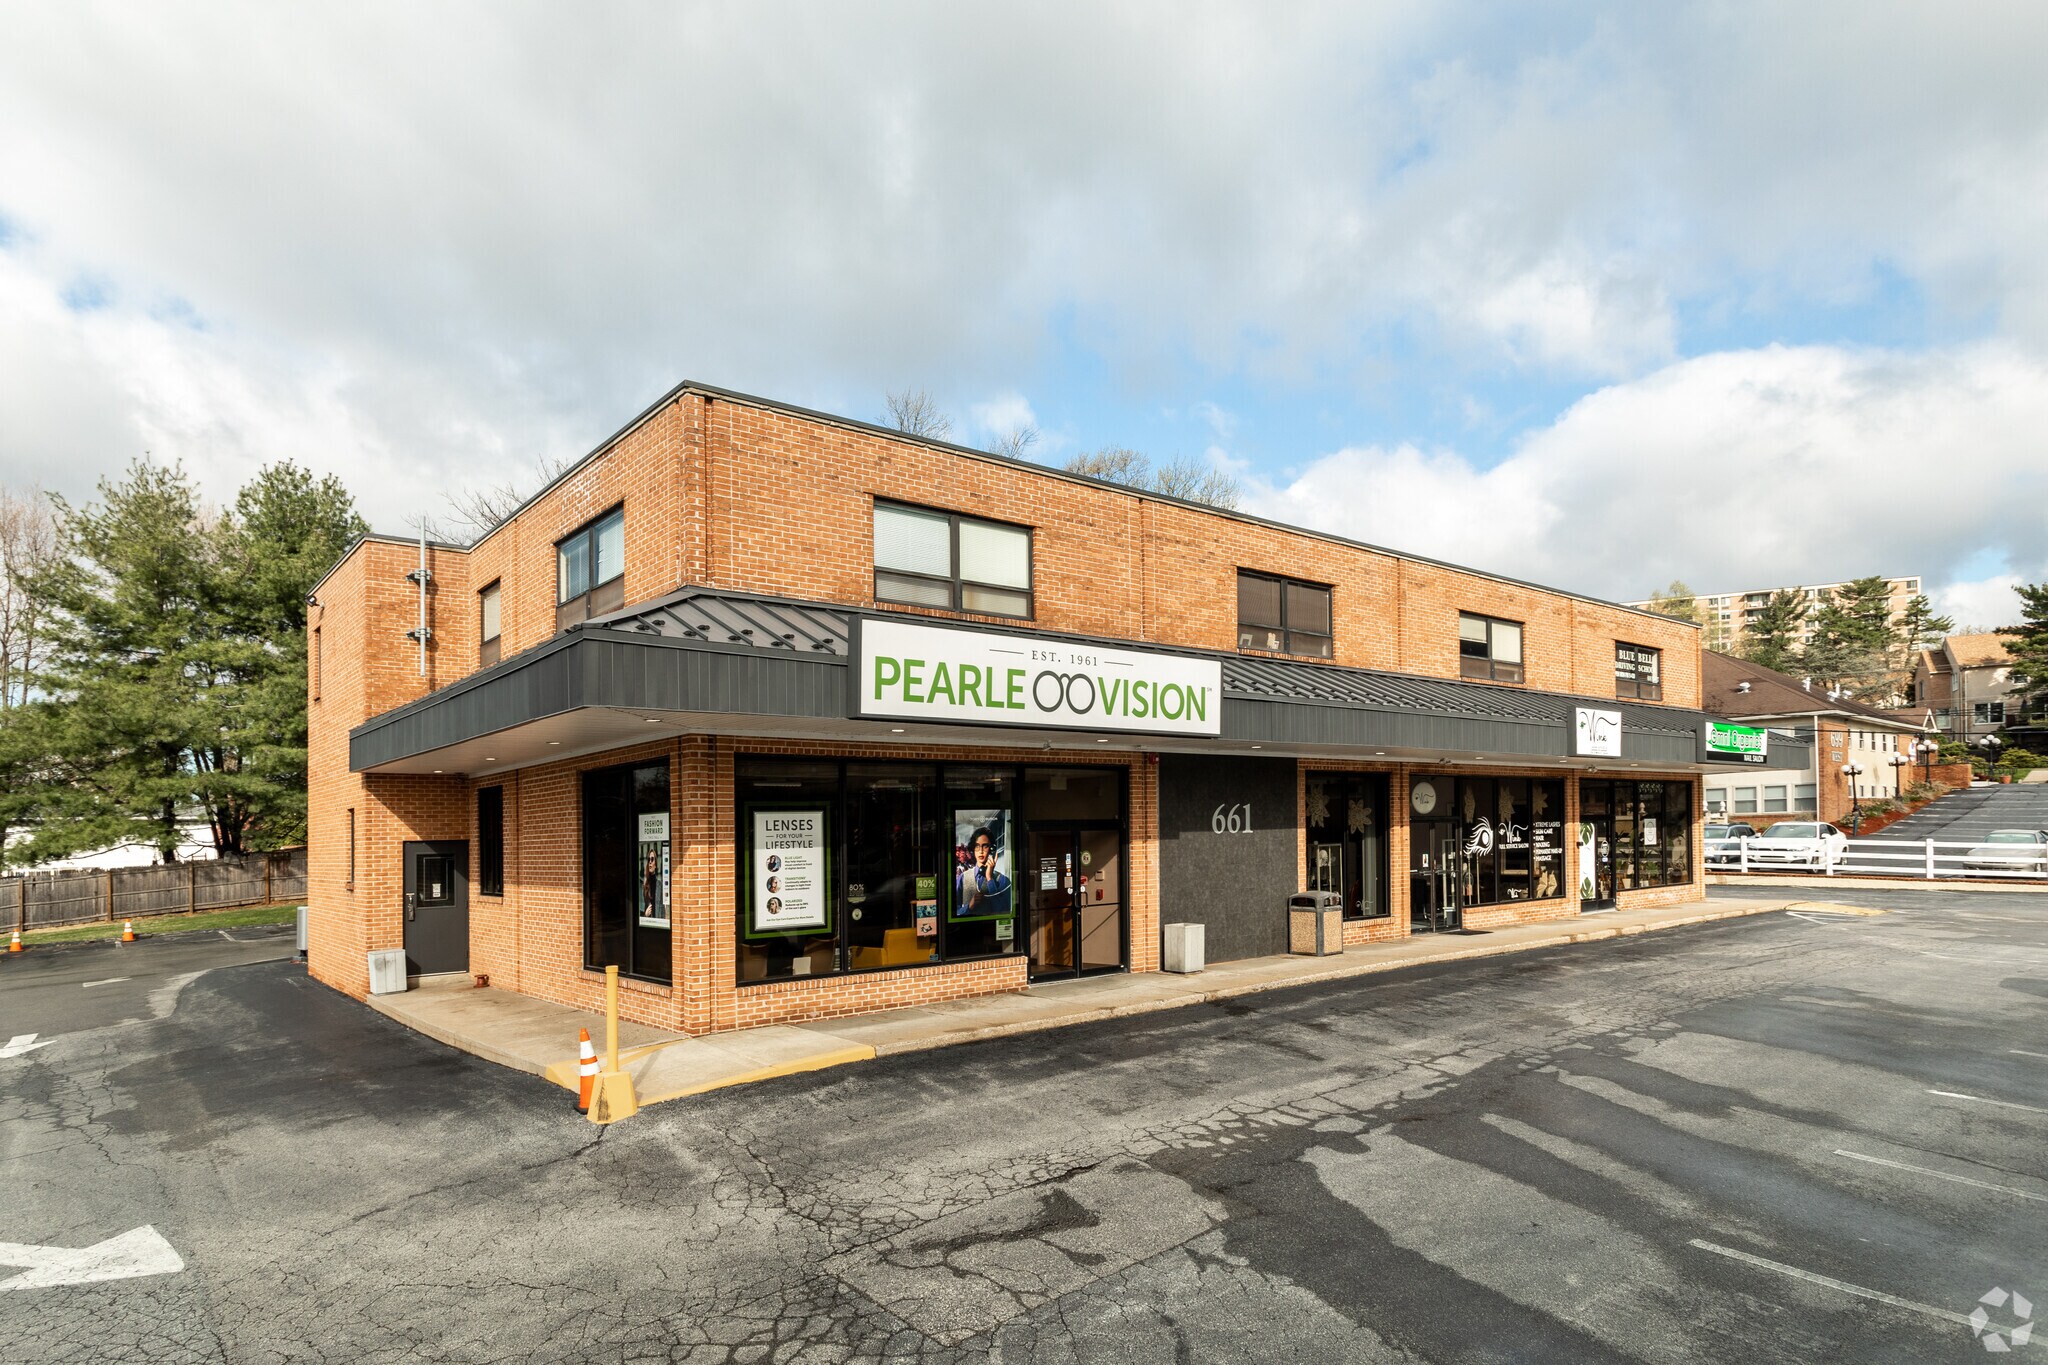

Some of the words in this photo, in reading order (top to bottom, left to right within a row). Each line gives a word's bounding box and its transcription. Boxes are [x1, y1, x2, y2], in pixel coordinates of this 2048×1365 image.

[1031, 650, 1061, 663] EST.
[1070, 654, 1098, 667] 1961
[1619, 650, 1635, 661] BLUE
[874, 655, 1026, 710] PEARLE
[1097, 676, 1206, 722] VISION
[1712, 728, 1730, 746] Omni
[1732, 730, 1762, 752] Organics
[766, 820, 813, 831] LENSES
[1211, 803, 1254, 834] 661
[766, 840, 814, 849] LIFESTYLE
[918, 880, 934, 888] 40%
